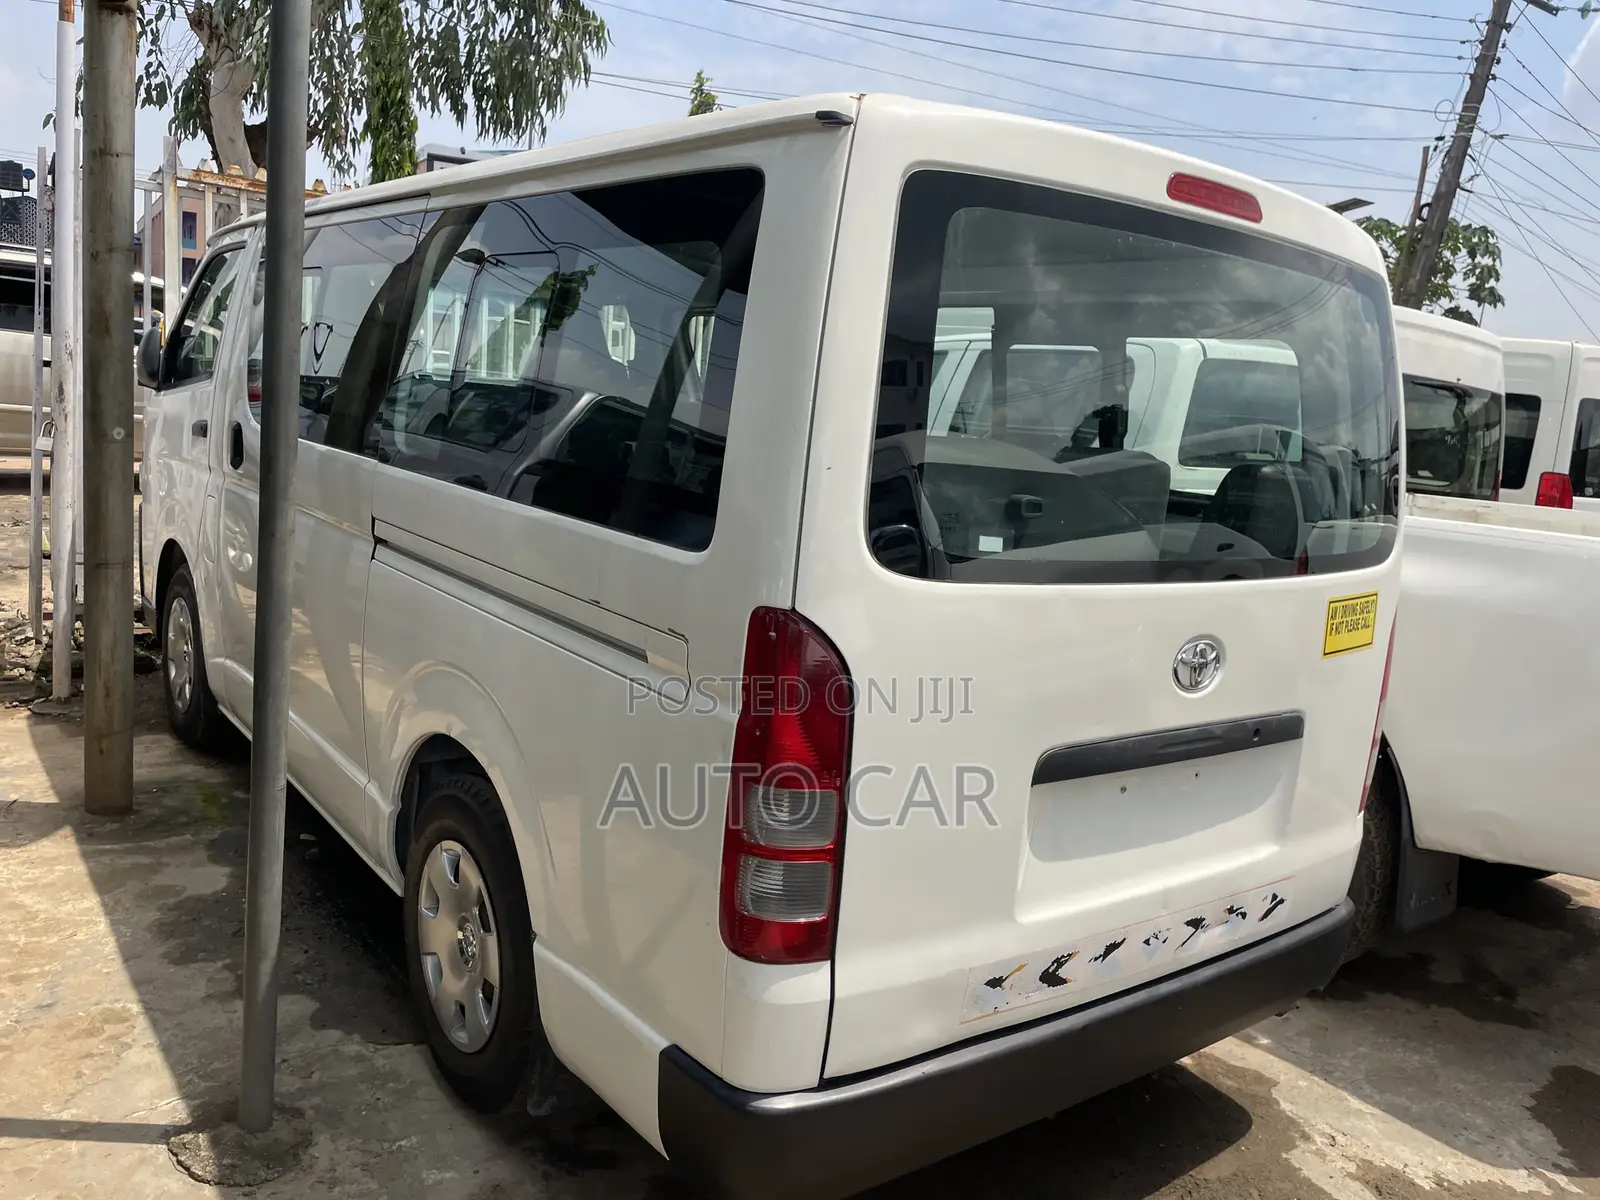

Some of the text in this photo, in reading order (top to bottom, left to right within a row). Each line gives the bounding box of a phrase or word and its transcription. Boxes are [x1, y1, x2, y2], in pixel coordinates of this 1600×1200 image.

[1330, 605, 1337, 621] AM
[1341, 602, 1358, 619] DRIVING
[1329, 621, 1335, 637] IF
[1334, 620, 1345, 636] NOT
[1344, 617, 1361, 634] PLEASE
